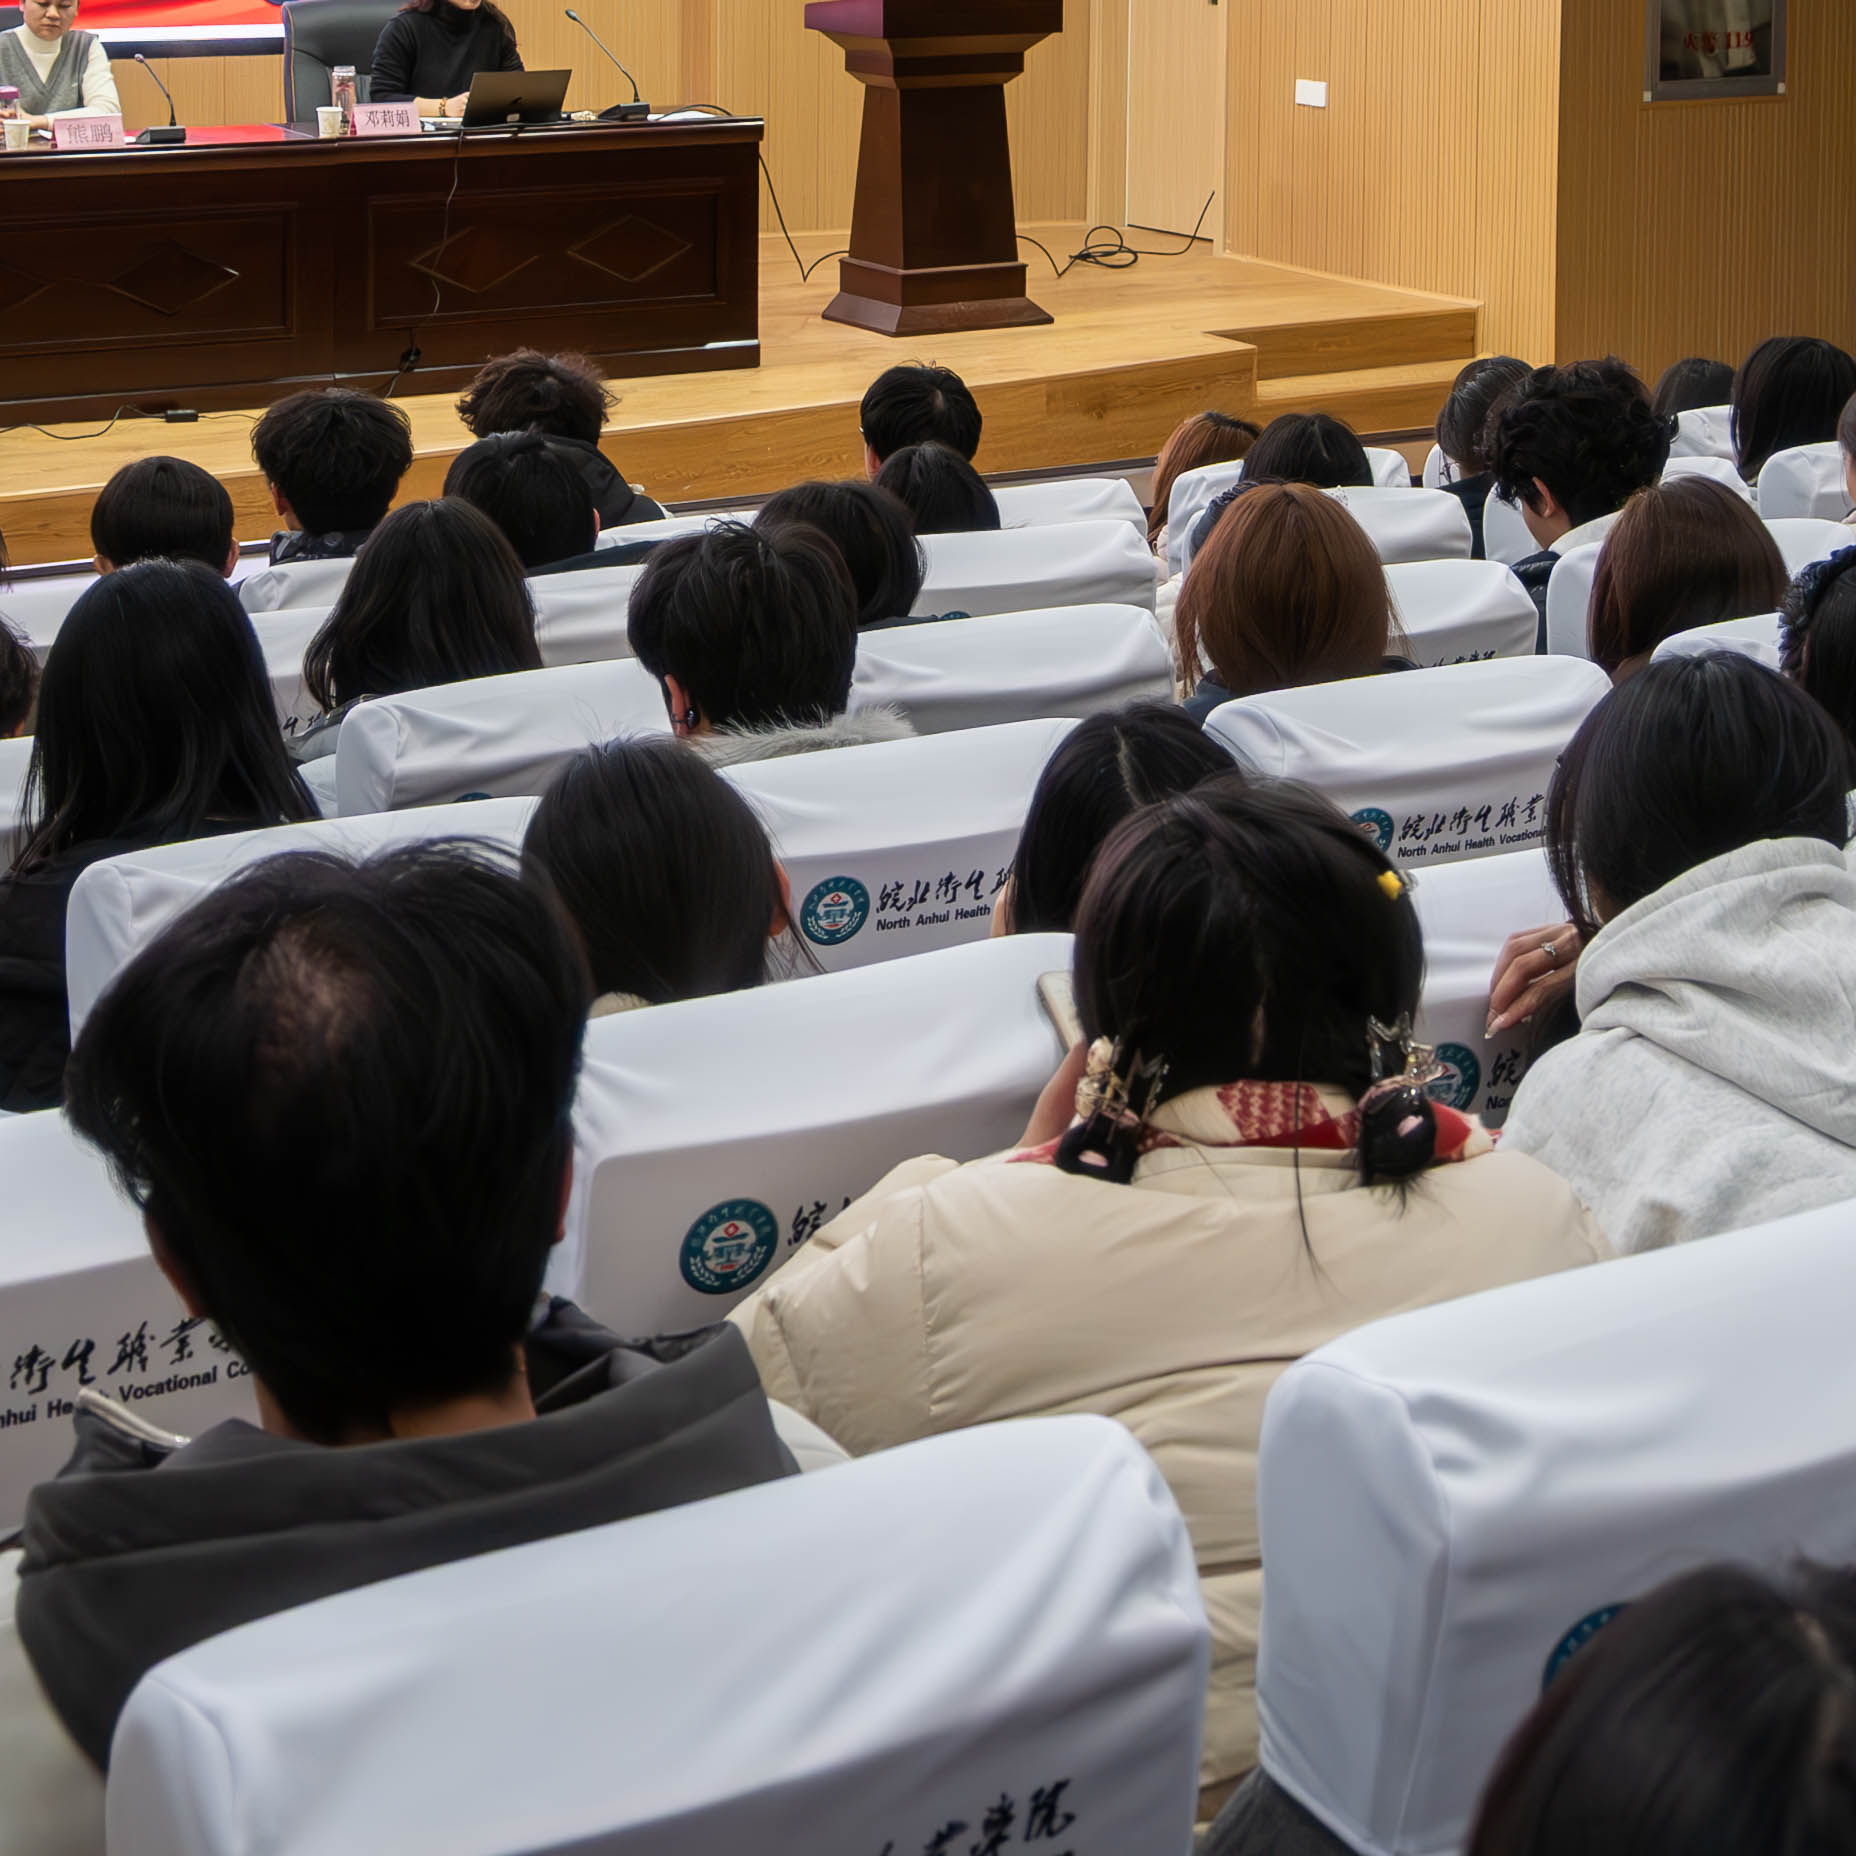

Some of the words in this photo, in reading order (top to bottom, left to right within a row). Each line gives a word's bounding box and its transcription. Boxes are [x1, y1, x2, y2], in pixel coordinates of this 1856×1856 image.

[1726, 31, 1753, 49] 119
[366, 109, 411, 128] 邓莉娟
[67, 124, 113, 144] 熊鹏
[1397, 846, 1427, 859] North
[1431, 842, 1461, 855] Anhui
[1464, 837, 1496, 851] Health
[875, 914, 911, 932] North
[915, 909, 951, 928] Anhui
[954, 903, 992, 921] Health
[117, 1365, 219, 1404] Vocational
